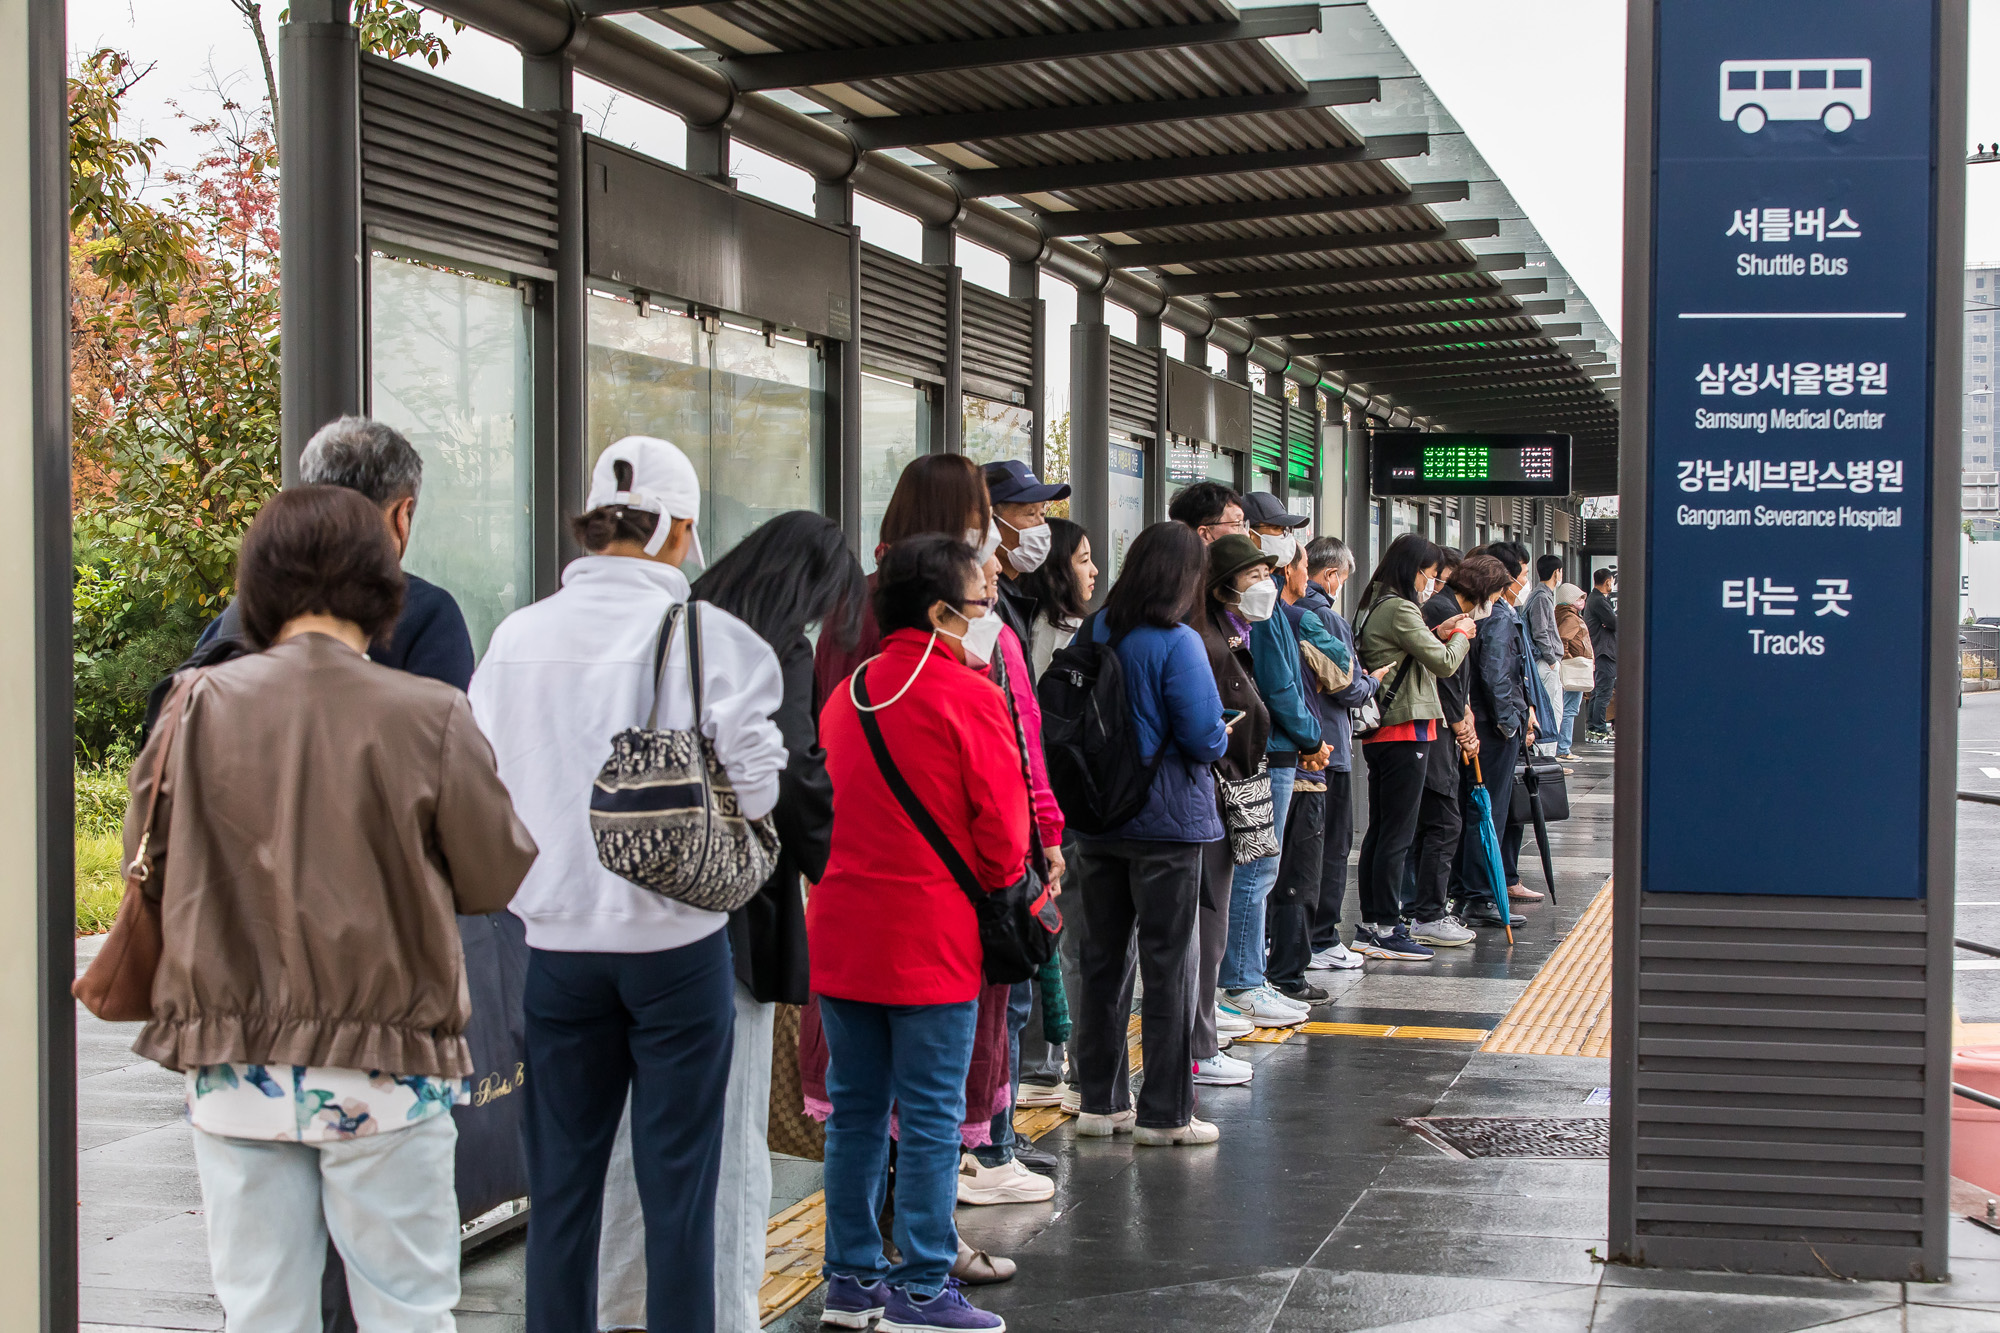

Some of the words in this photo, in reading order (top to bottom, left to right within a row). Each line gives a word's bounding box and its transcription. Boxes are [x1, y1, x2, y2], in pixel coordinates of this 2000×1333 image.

[1725, 207, 1861, 242] 셔틀버스
[1736, 253, 1806, 276] Shuttle
[1810, 253, 1848, 276] Bus
[1695, 362, 1888, 396] 삼성서울병원
[1695, 408, 1767, 433] Samsung
[1770, 409, 1831, 430] Medical
[1833, 409, 1886, 430] Center
[1676, 460, 1904, 494] 강남세브란스병원
[1677, 505, 1751, 530] Gangnam
[1754, 505, 1836, 527] Severance
[1839, 506, 1902, 531] Hospital
[1722, 577, 1799, 616] 타는
[1811, 578, 1853, 617] 곳
[1748, 629, 1825, 656] Tracks
